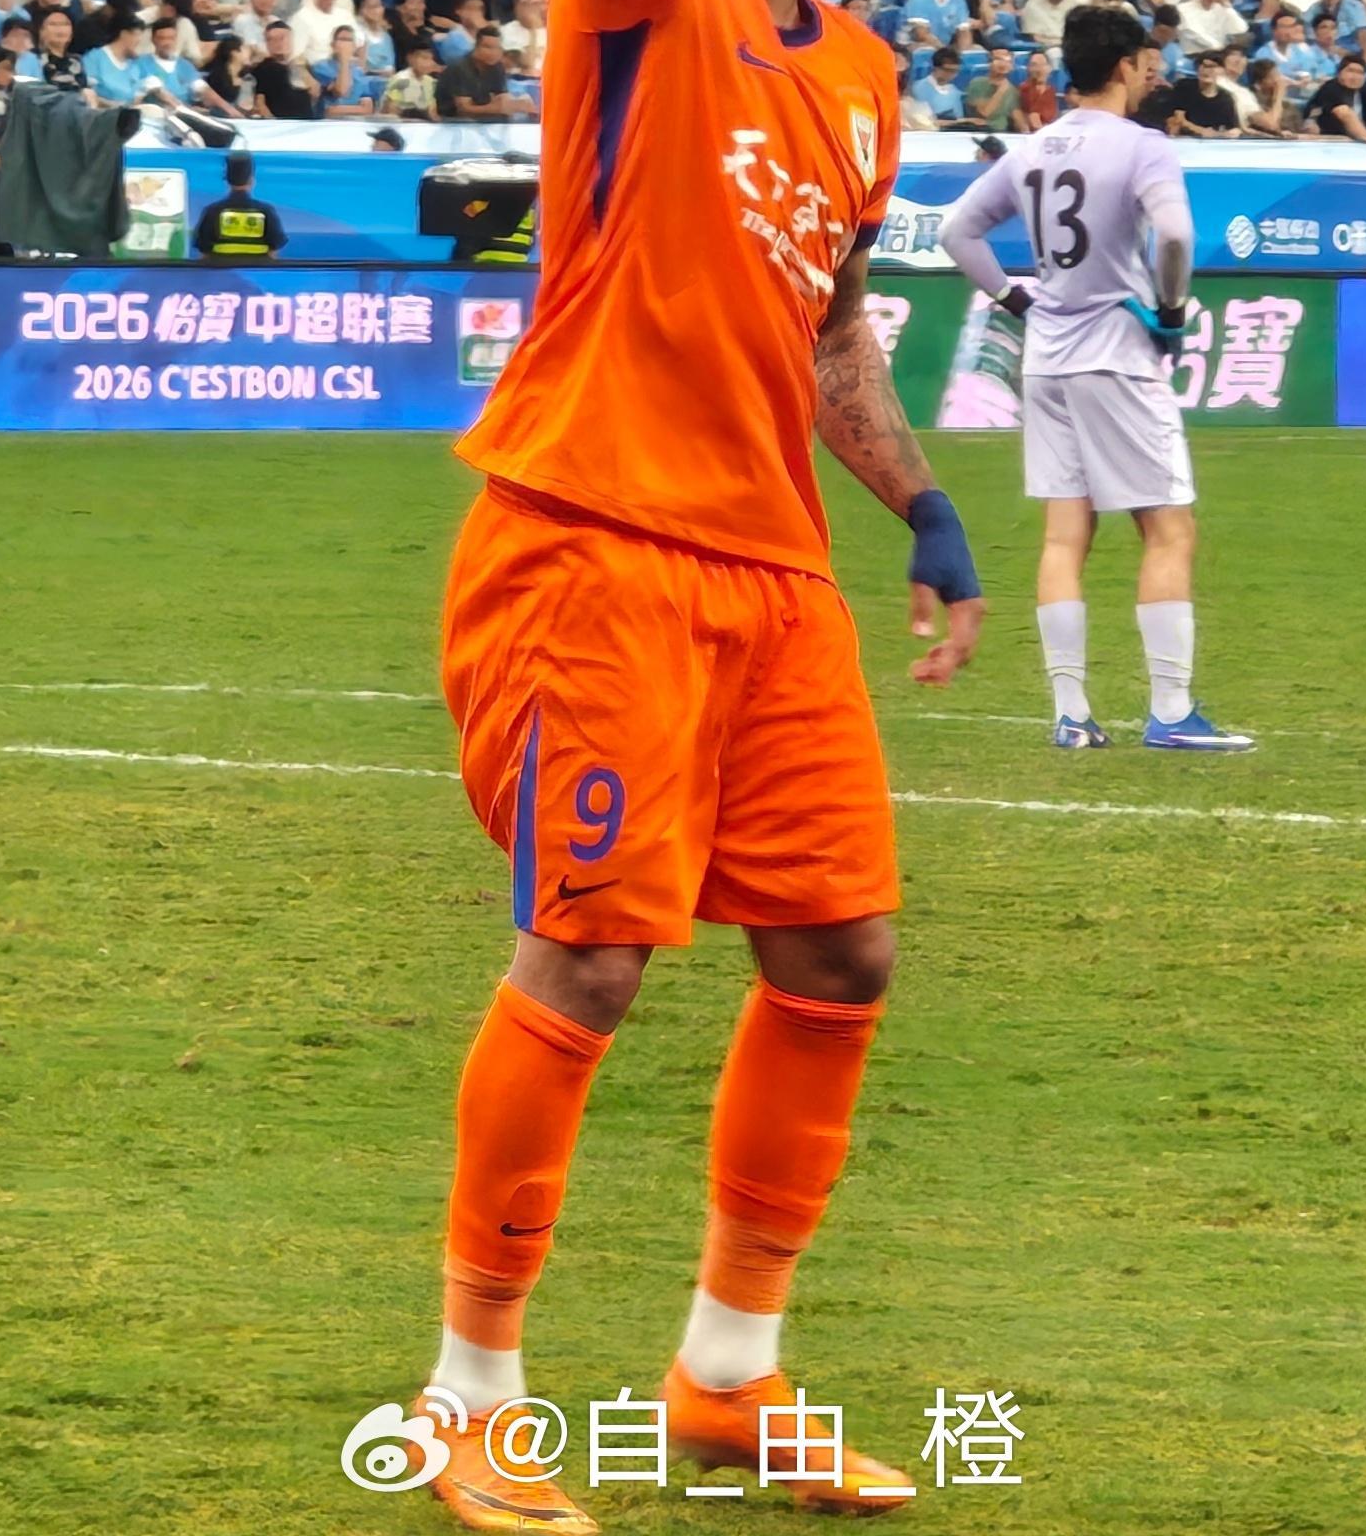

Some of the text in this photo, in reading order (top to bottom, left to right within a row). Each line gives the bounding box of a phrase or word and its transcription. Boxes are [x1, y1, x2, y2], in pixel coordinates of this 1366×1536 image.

[1024, 168, 1091, 269] 13
[22, 292, 150, 341] 2026
[72, 364, 152, 401] 2026
[322, 364, 382, 400] CSL
[568, 766, 626, 862] 9
